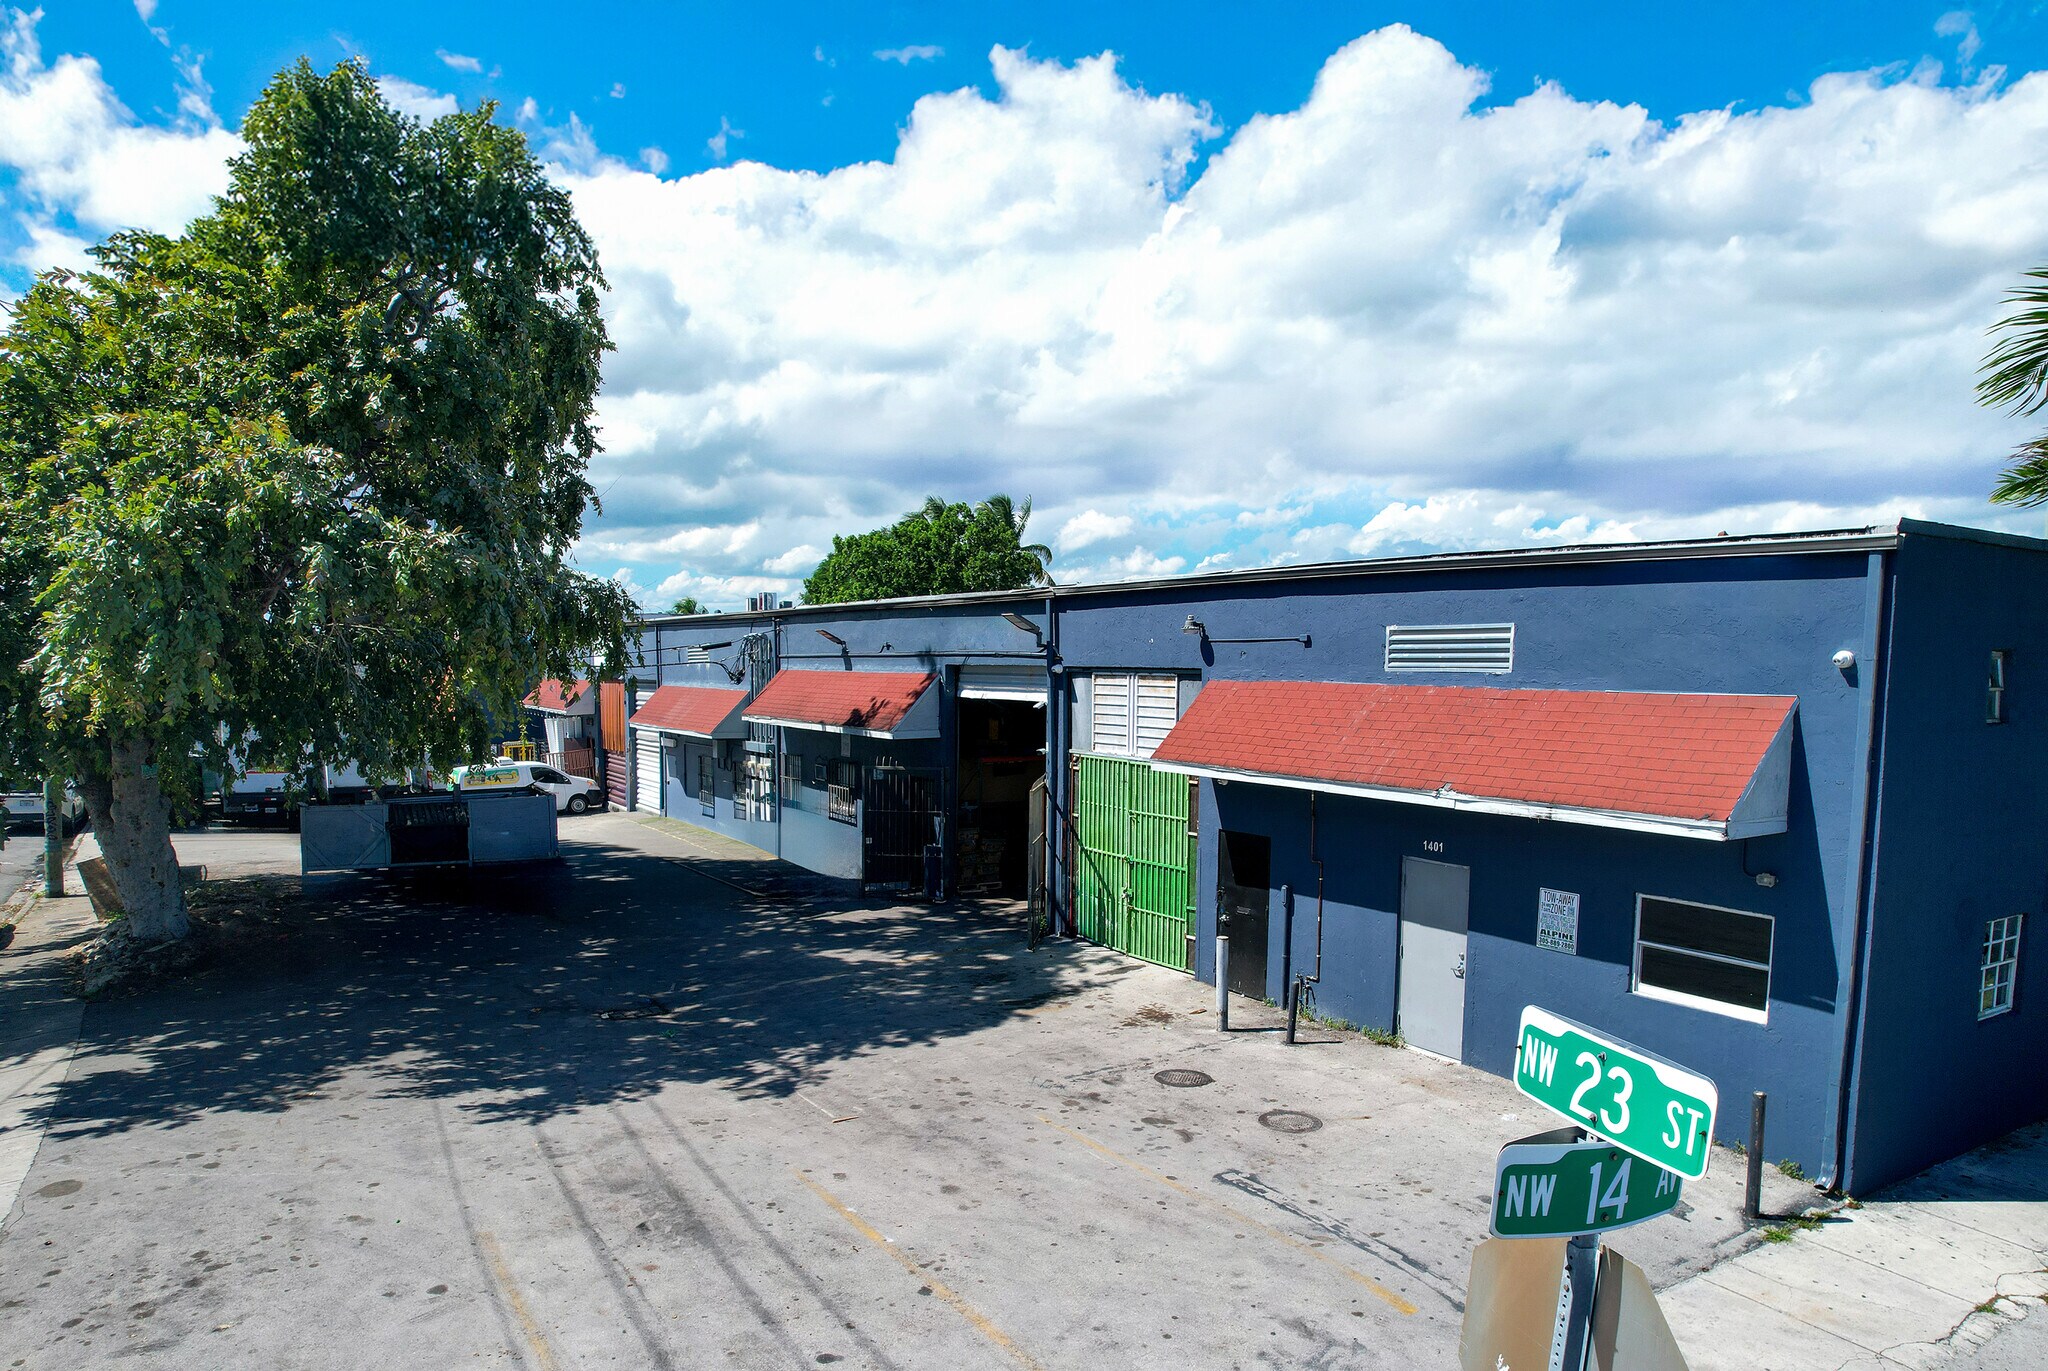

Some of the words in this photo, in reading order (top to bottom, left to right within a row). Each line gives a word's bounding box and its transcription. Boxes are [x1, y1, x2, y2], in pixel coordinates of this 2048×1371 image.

[1423, 840, 1443, 853] 1401
[1544, 891, 1575, 906] TOW-AWAY
[1551, 904, 1566, 916] ZONE
[1540, 929, 1574, 941] ALPINE
[1523, 1034, 1558, 1087] NW
[1570, 1052, 1633, 1133] 23
[1663, 1100, 1703, 1156] ST
[1505, 1174, 1557, 1217] NW
[1586, 1158, 1632, 1224] 14
